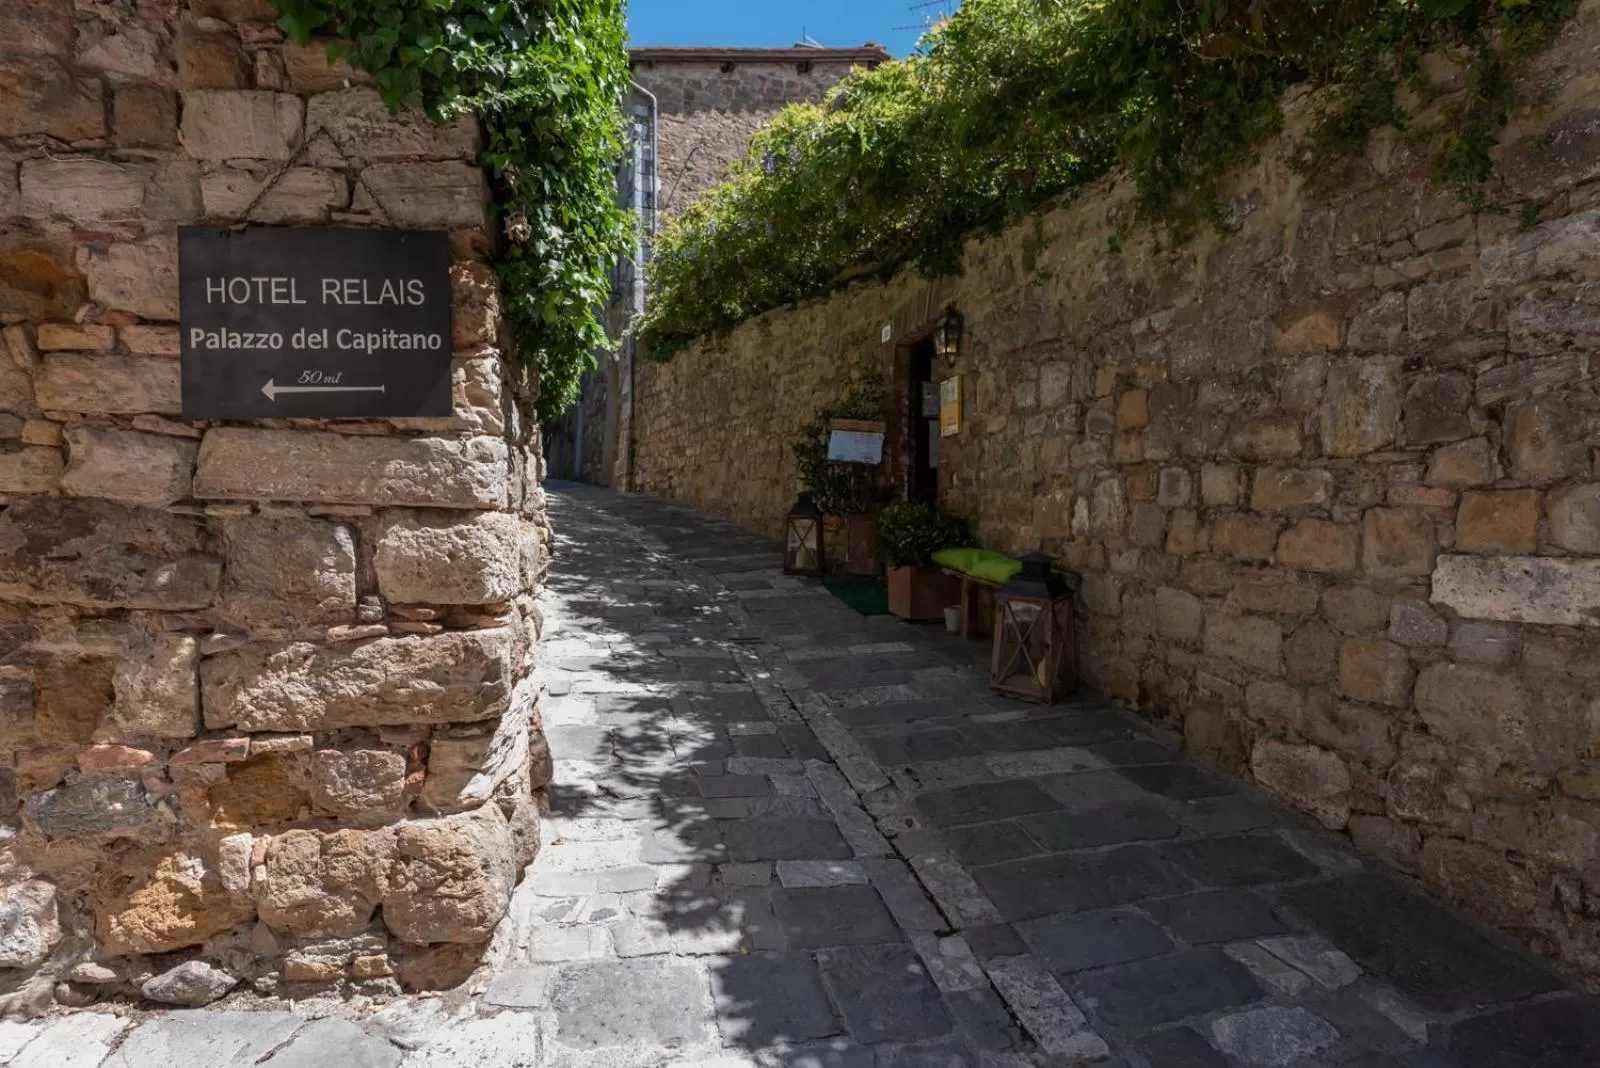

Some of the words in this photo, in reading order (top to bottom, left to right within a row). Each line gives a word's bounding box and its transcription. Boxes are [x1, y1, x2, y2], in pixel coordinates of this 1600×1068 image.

[206, 277, 307, 304] HOTEL
[321, 278, 425, 305] RELAIS
[190, 327, 283, 349] Palazzo
[291, 328, 328, 349] del
[336, 328, 442, 355] Capitano
[298, 370, 323, 384] 50
